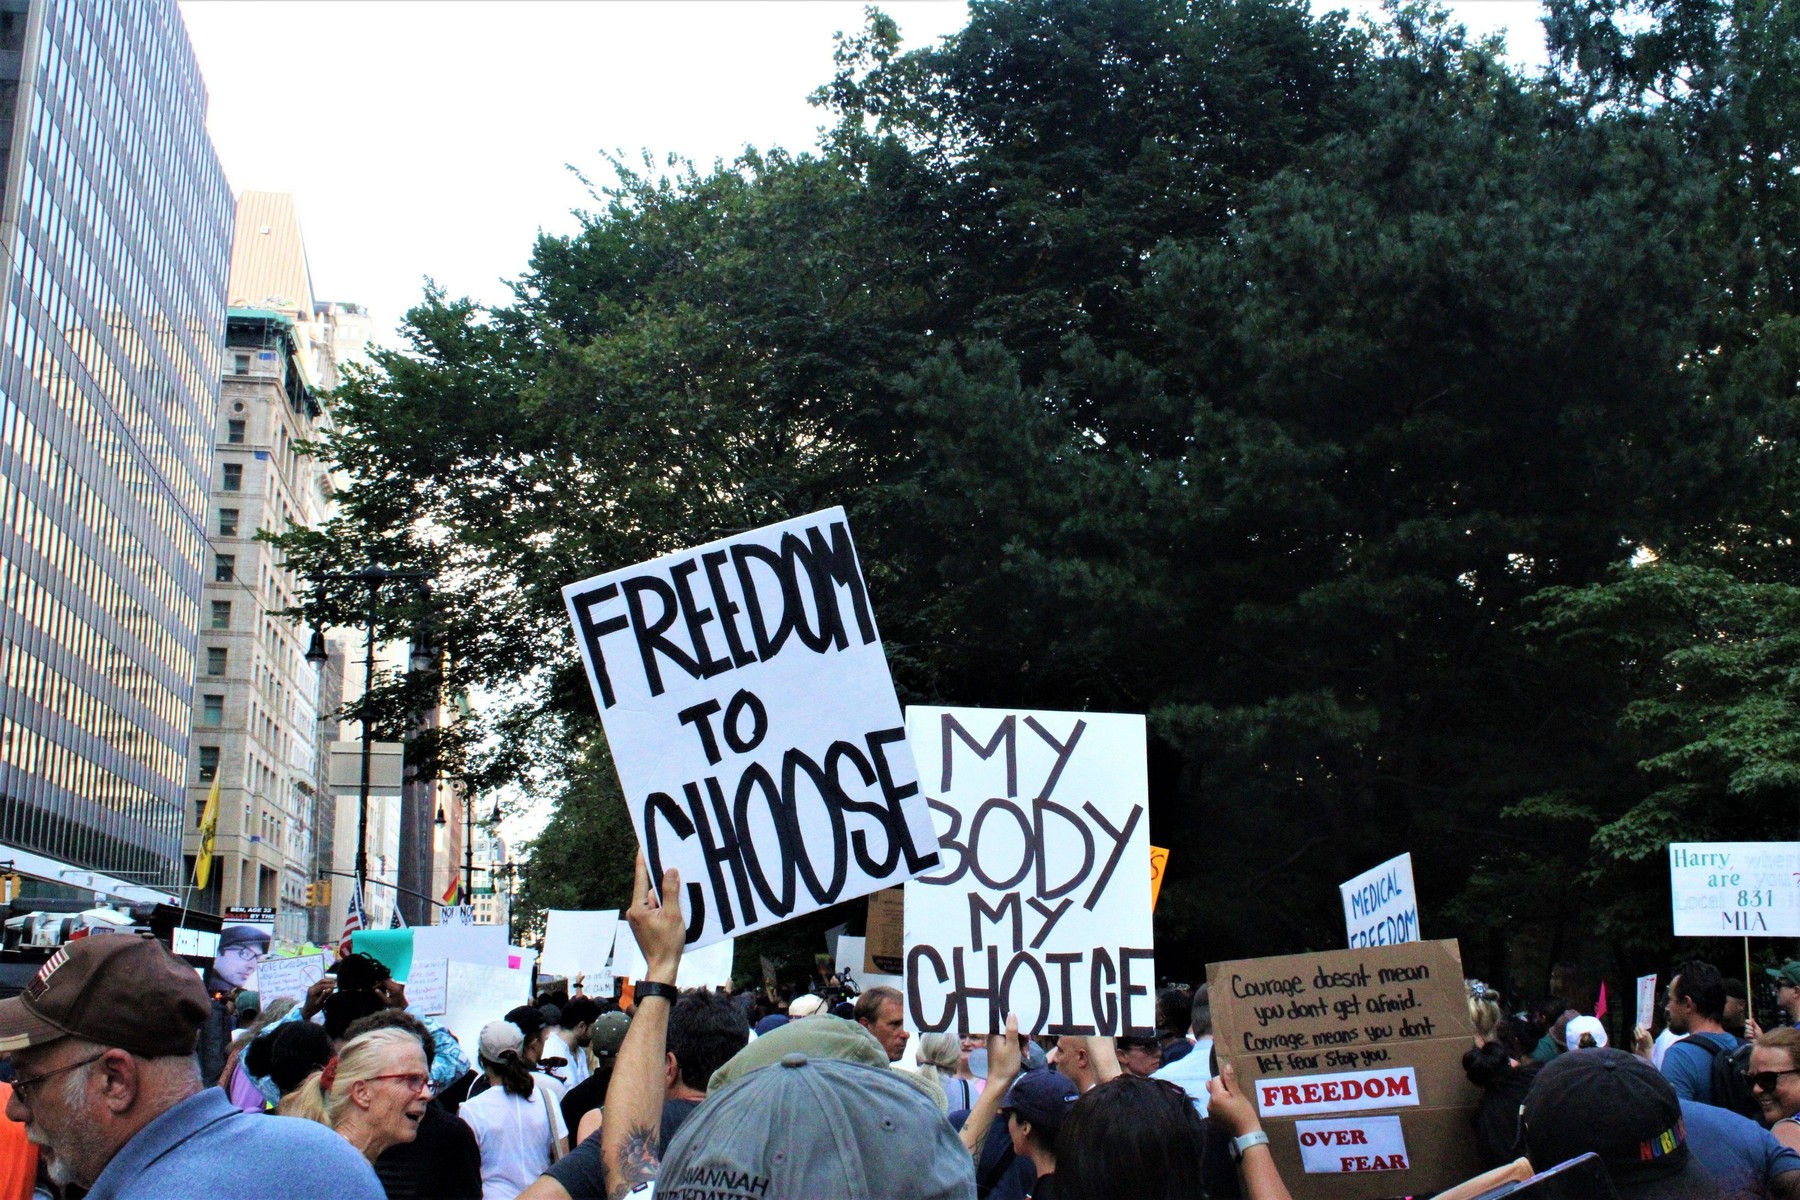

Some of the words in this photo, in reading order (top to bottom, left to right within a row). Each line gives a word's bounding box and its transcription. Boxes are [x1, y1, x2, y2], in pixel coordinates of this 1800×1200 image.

[571, 522, 876, 709] FREEDOM
[677, 688, 768, 766] TO
[940, 713, 1087, 802] MY
[644, 727, 939, 944] CHOOSE
[914, 797, 1143, 912] BODY
[1745, 851, 1800, 868] wher
[1351, 867, 1402, 920] MEDICAL
[1708, 873, 1740, 888] are
[1737, 889, 1773, 908] 831
[968, 891, 1074, 952] MY
[1350, 904, 1418, 949] FREEDOM
[1722, 911, 1769, 931] MIA
[907, 944, 1155, 1037] CHOICE
[1232, 974, 1305, 999] Courage
[1313, 963, 1371, 989] doesnt
[1378, 964, 1430, 985] mean
[1254, 1003, 1284, 1026] you
[1287, 997, 1329, 1019] dont
[1333, 994, 1361, 1021] get
[1366, 988, 1422, 1013] afraid.
[1243, 1031, 1308, 1051] Courage
[1312, 1026, 1359, 1046] means
[1364, 1024, 1393, 1042] you
[1399, 1017, 1435, 1038] dont
[1256, 1053, 1283, 1074] let
[1287, 1051, 1319, 1070] fear
[1360, 1049, 1391, 1066] you.
[1262, 1076, 1412, 1107] FREEDOM
[1300, 1129, 1368, 1146] OVER
[1340, 1154, 1407, 1172] FEAR
[680, 1166, 769, 1197] AVANNAH
